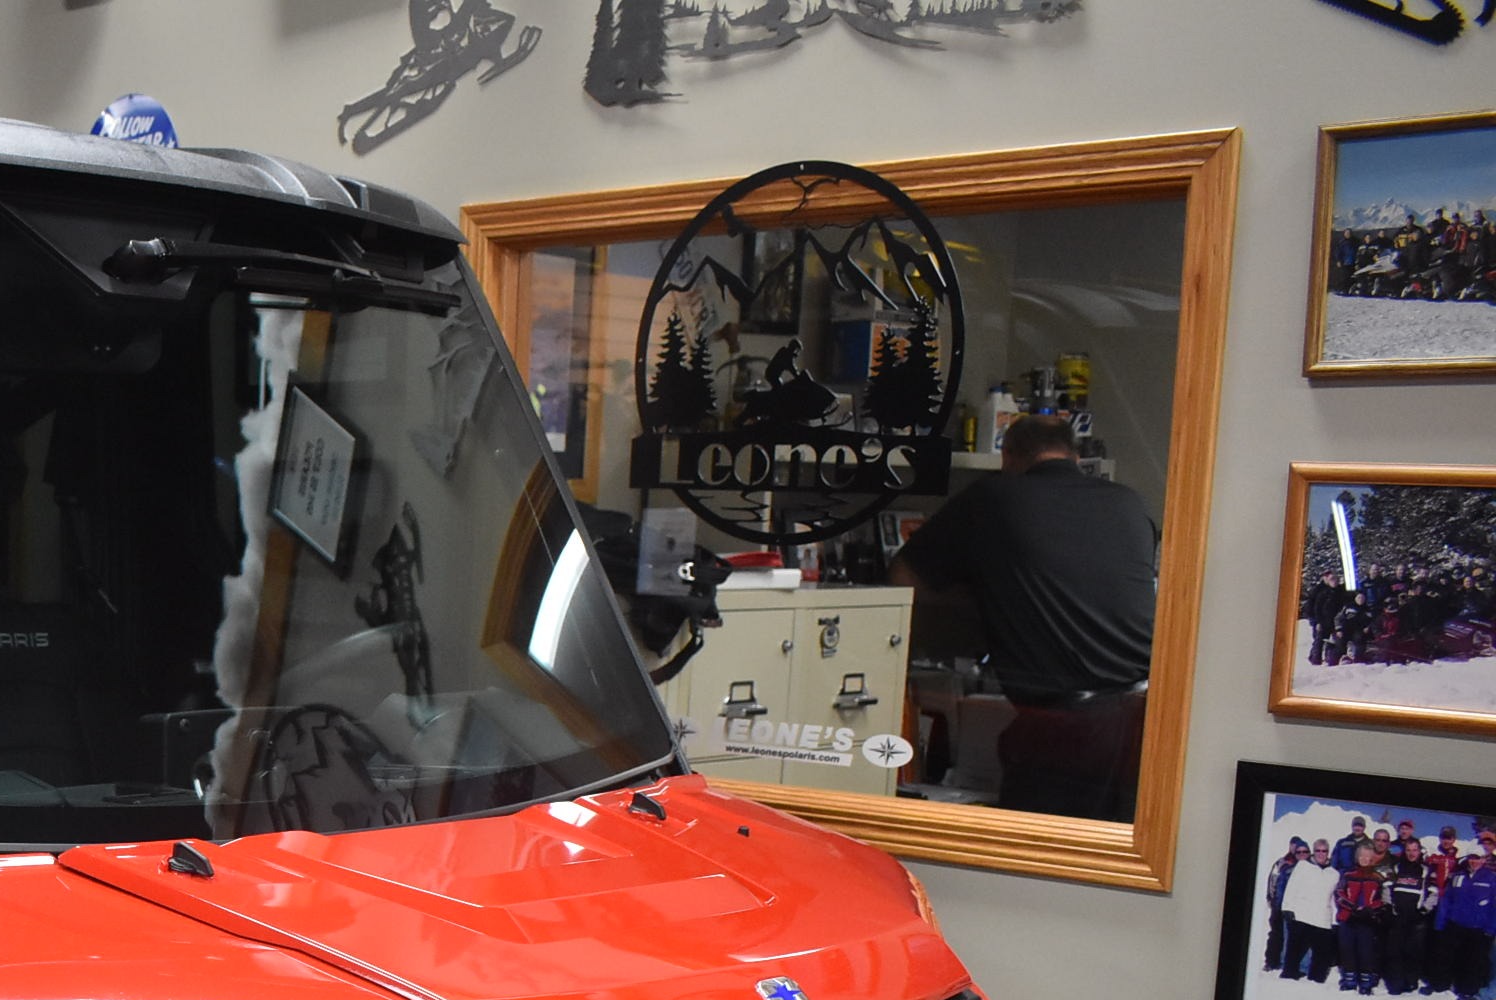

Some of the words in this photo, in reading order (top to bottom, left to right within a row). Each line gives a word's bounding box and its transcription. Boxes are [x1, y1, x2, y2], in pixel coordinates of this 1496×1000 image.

[99, 115, 155, 141] OLLOW
[658, 437, 916, 490] Leone's
[725, 745, 841, 764] www.leonespolaris.com
